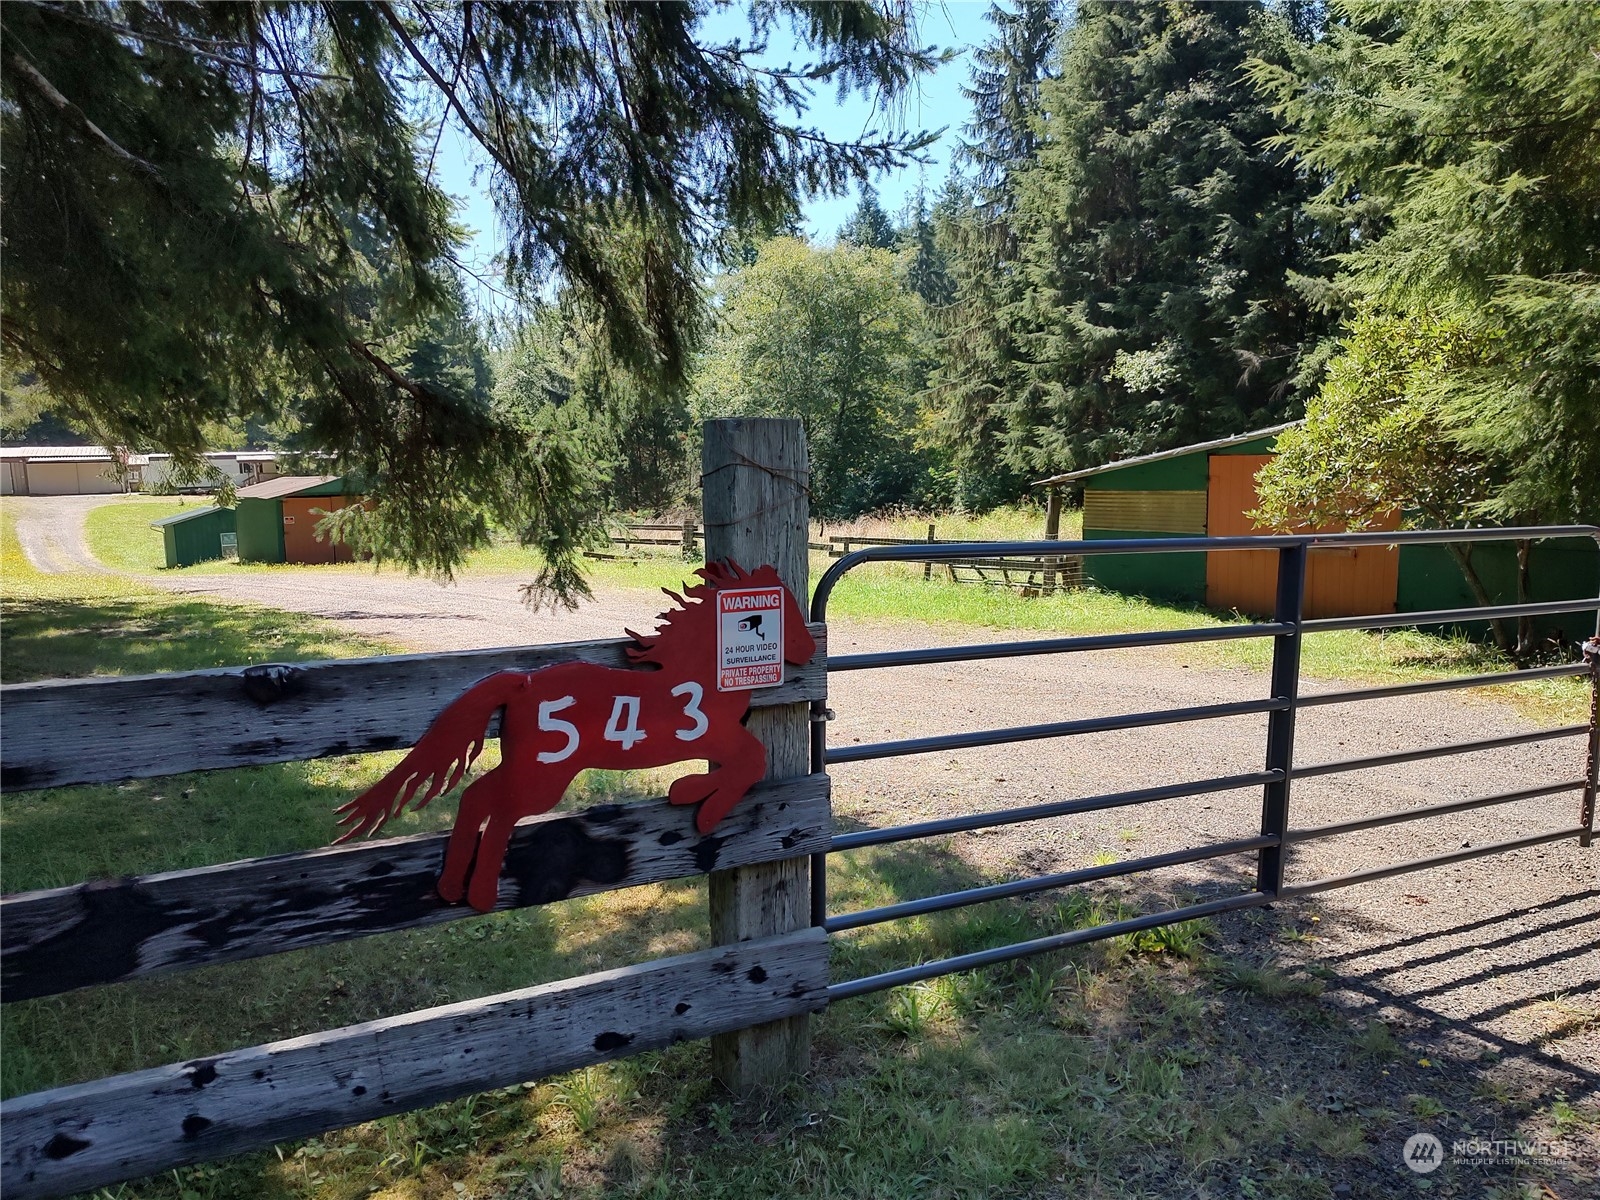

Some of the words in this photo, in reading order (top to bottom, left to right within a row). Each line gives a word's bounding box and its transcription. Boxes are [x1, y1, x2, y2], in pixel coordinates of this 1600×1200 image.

[722, 594, 780, 611] WARNING
[725, 647, 734, 655] 24
[735, 645, 755, 654] HOUR
[756, 642, 778, 652] VIDEO
[726, 654, 777, 665] SURVEILLANCE
[721, 667, 748, 679] PRIVATE
[748, 664, 781, 676] PROPERTY
[724, 677, 734, 687] NO
[735, 673, 777, 685] TRESPASSING
